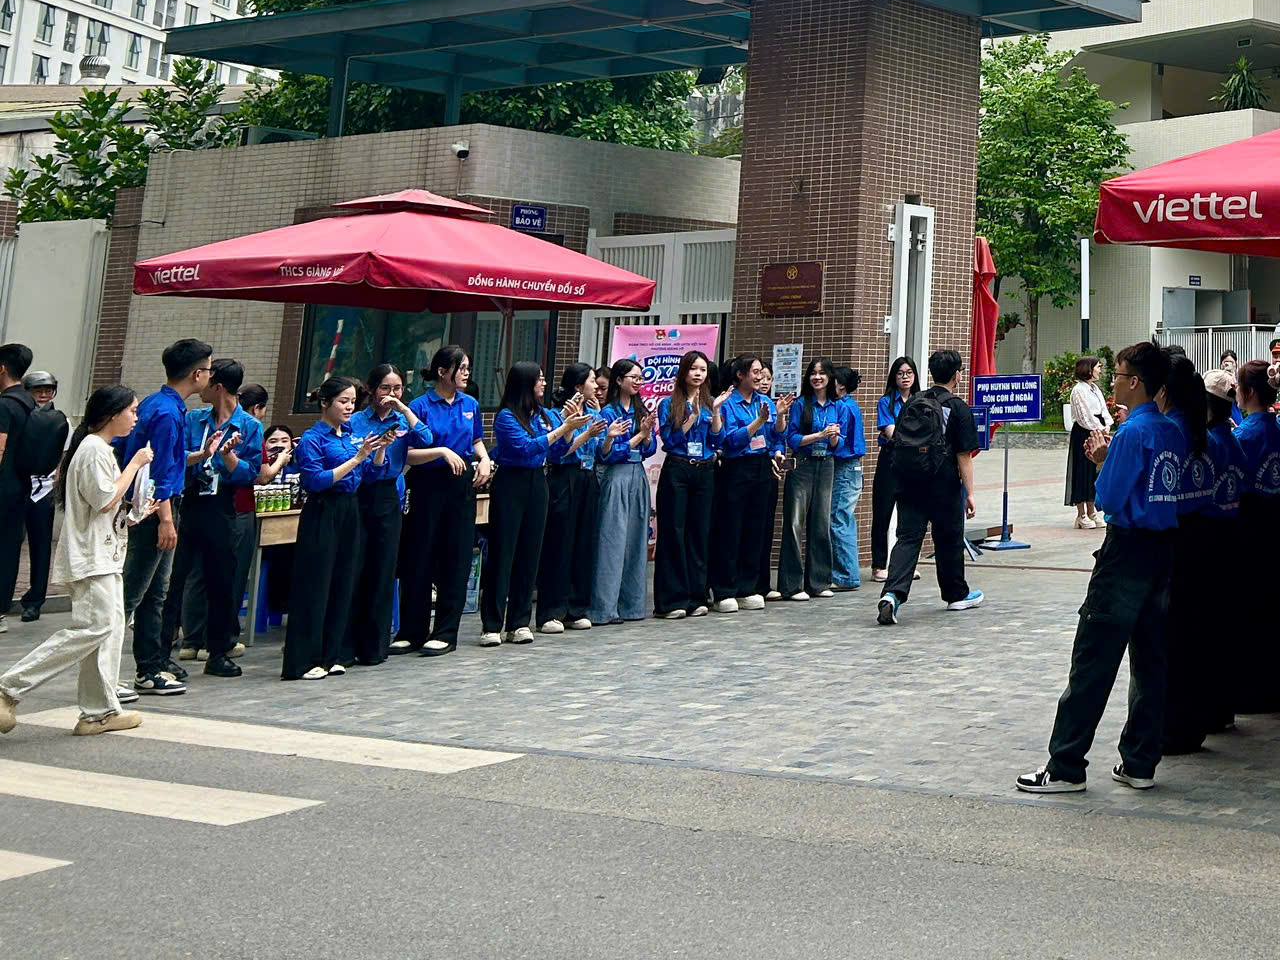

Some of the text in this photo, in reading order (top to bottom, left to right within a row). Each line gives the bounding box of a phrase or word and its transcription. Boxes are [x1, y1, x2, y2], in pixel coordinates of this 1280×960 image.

[1132, 190, 1263, 224] viettel
[515, 215, 530, 225] BẢO
[149, 264, 200, 285] viettel
[280, 266, 303, 277] THCS
[306, 263, 332, 277] GIẢNG
[468, 273, 587, 295] ĐỒNG HÀNH CHUYỂN ĐỔI SỐ
[977, 383, 989, 392] PHỤ
[1011, 382, 1020, 390] VUI
[1022, 380, 1037, 389] LÒNG
[983, 394, 995, 402] ĐÓN
[996, 394, 1008, 402] CON
[1015, 392, 1033, 401] NGOÀI
